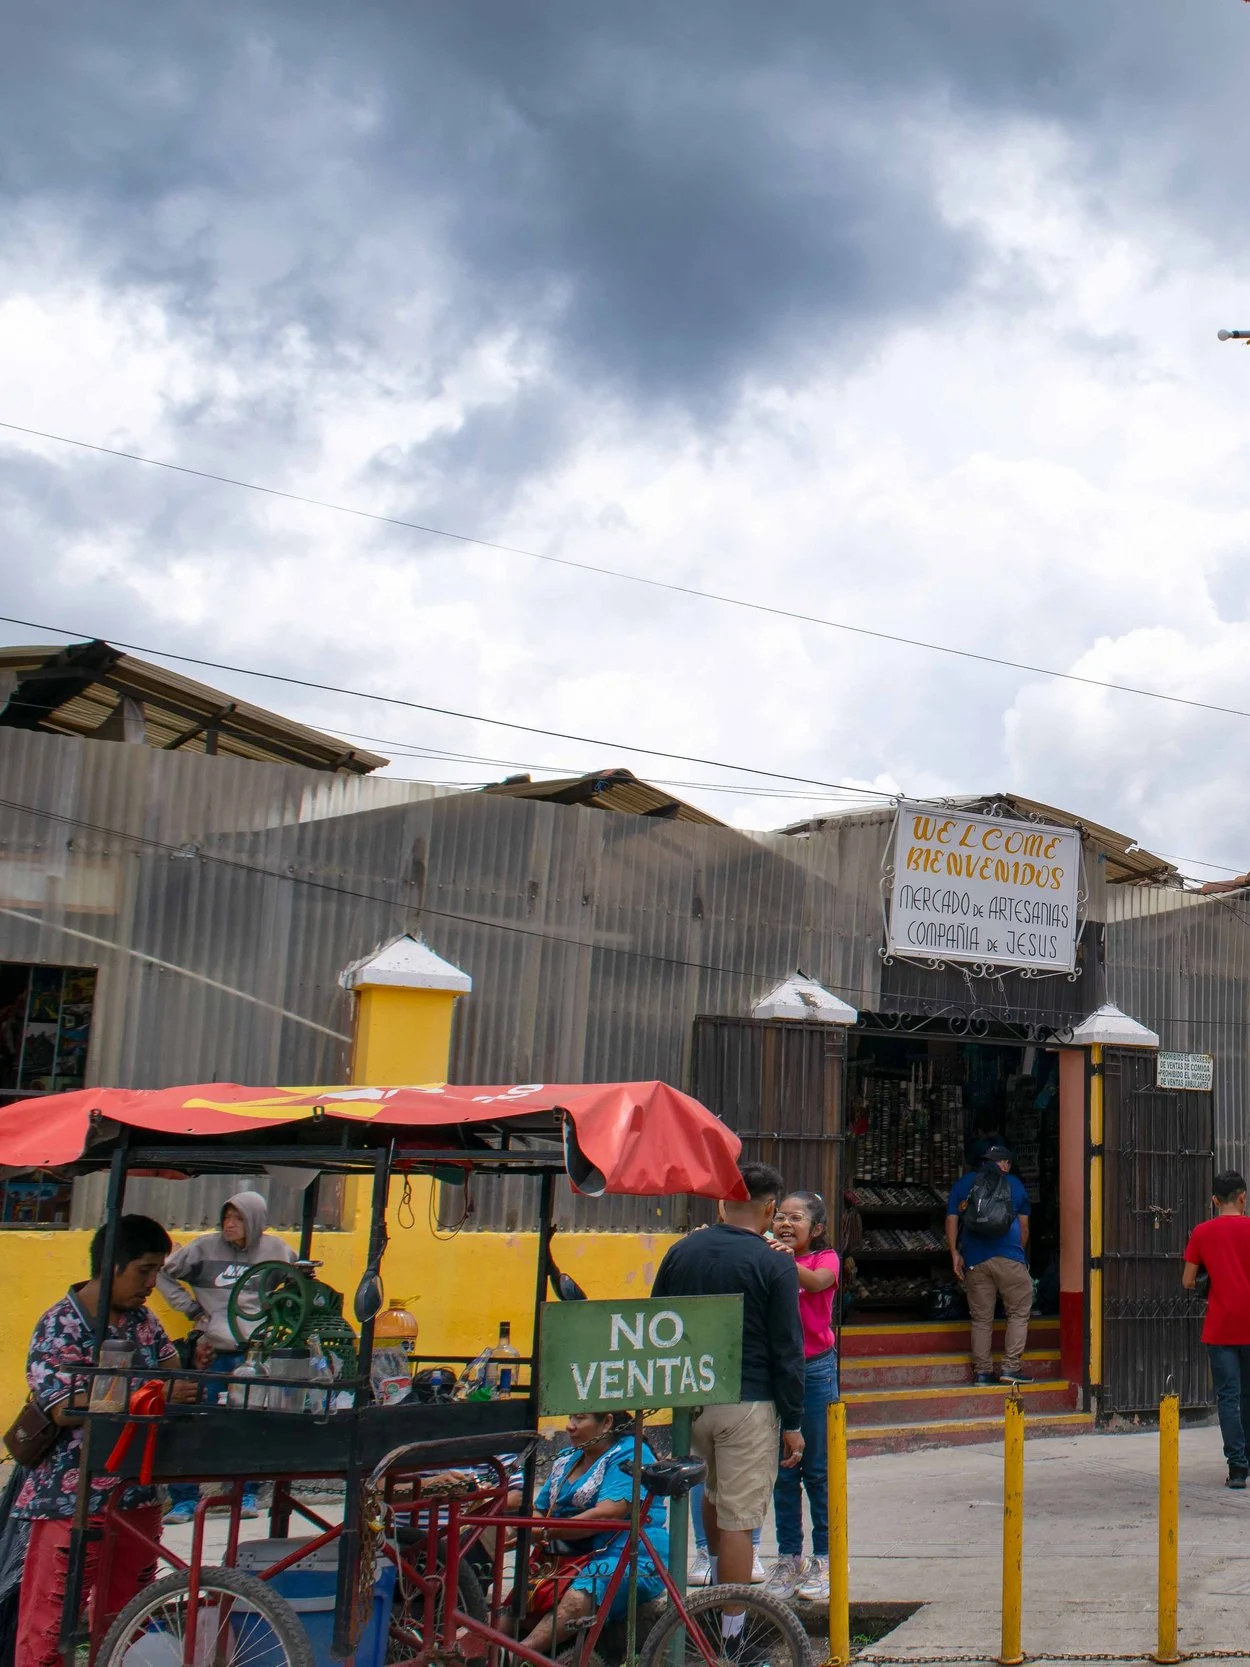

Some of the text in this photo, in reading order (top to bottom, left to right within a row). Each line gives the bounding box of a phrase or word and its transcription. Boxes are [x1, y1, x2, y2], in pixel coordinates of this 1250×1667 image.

[912, 815, 1063, 860] WELCOME
[906, 846, 1065, 890] BIENVENIDOS
[899, 884, 1069, 928] MERCADO DE ARTESANIAS
[907, 920, 1057, 959] COMPAÑIA DE JESUS
[1160, 1053, 1211, 1064] PROHIBIDO EL INGRESO
[1160, 1070, 1211, 1081] PROHIBIDO EL INGRESO
[1167, 1062, 1183, 1070] VENTAS
[1184, 1063, 1190, 1071] DE
[1191, 1064, 1210, 1072] COMIDA
[1160, 1078, 1166, 1086] DE
[1167, 1078, 1184, 1087] VENTAS
[223, 1264, 250, 1276] NIK
[609, 1310, 684, 1351] NO
[569, 1353, 716, 1400] VENTAS
